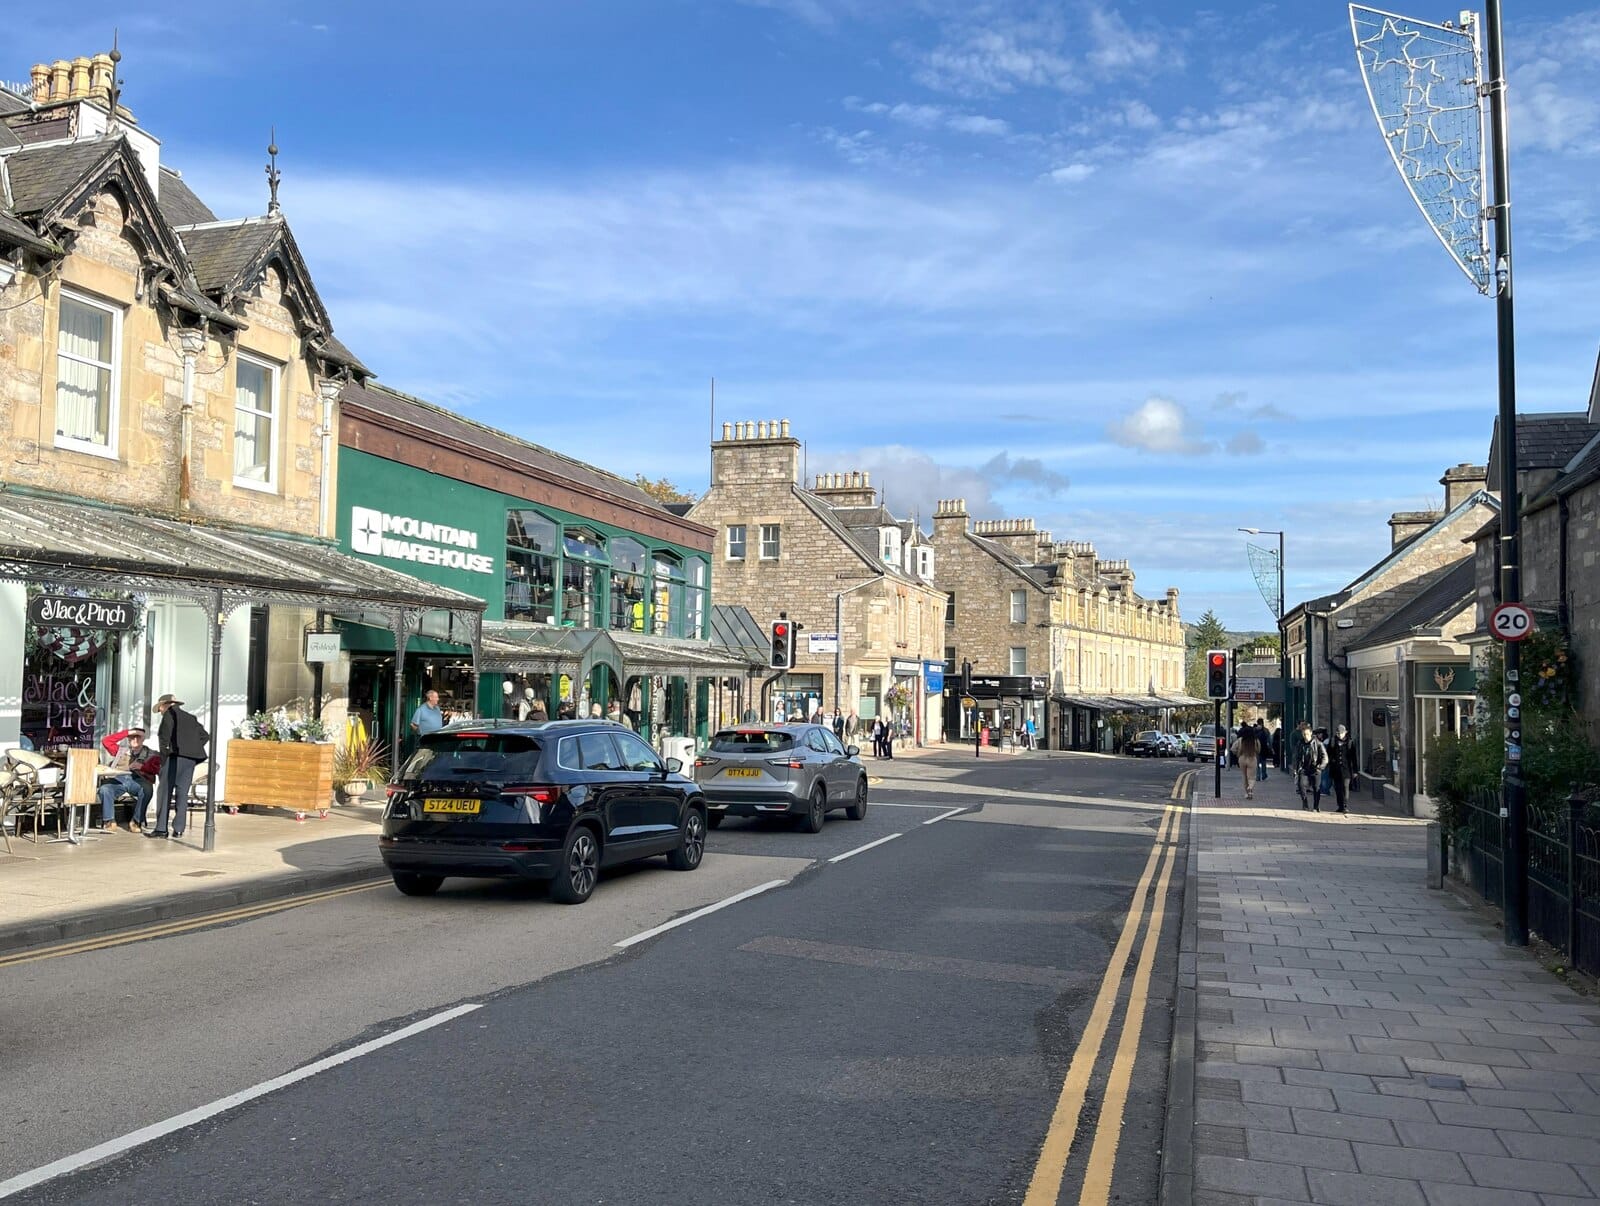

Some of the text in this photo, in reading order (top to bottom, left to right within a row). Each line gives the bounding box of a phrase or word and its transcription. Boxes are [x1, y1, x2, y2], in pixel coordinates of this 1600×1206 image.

[382, 513, 478, 549] MOUNTAIN
[382, 537, 494, 574] WAREHOUSE
[1497, 614, 1528, 630] 20
[24, 673, 97, 708] Mac &
[429, 800, 475, 811] ST24 UEU
